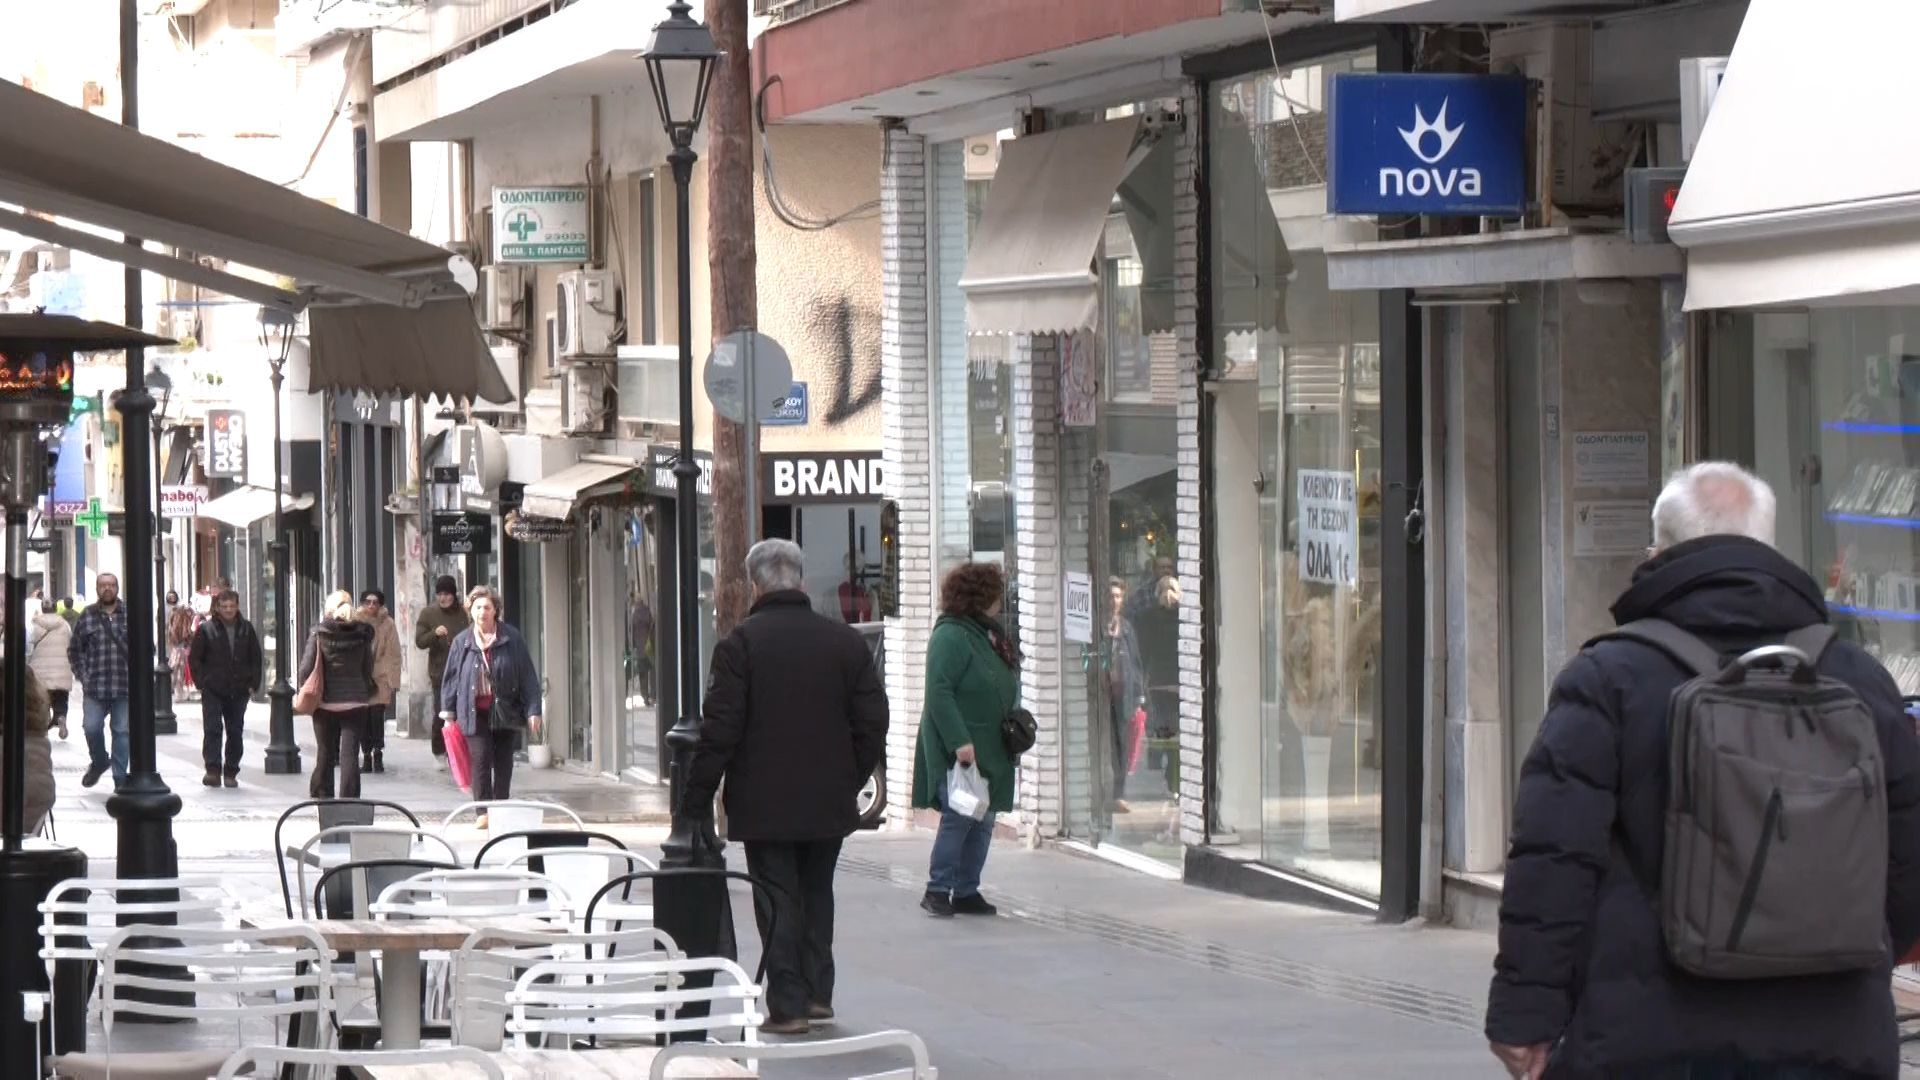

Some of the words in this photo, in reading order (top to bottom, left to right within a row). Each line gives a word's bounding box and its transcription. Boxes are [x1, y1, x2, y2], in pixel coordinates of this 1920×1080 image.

[1379, 167, 1481, 196] nova
[500, 191, 585, 204] ΟΔΟΝΤΙΑΤΡΕΙΟ
[774, 459, 884, 496] BRAND
[1307, 507, 1319, 530] ΤΗ
[1321, 508, 1349, 533] ΣΕΖΟΝ
[1306, 540, 1333, 580] ΟΛΑ
